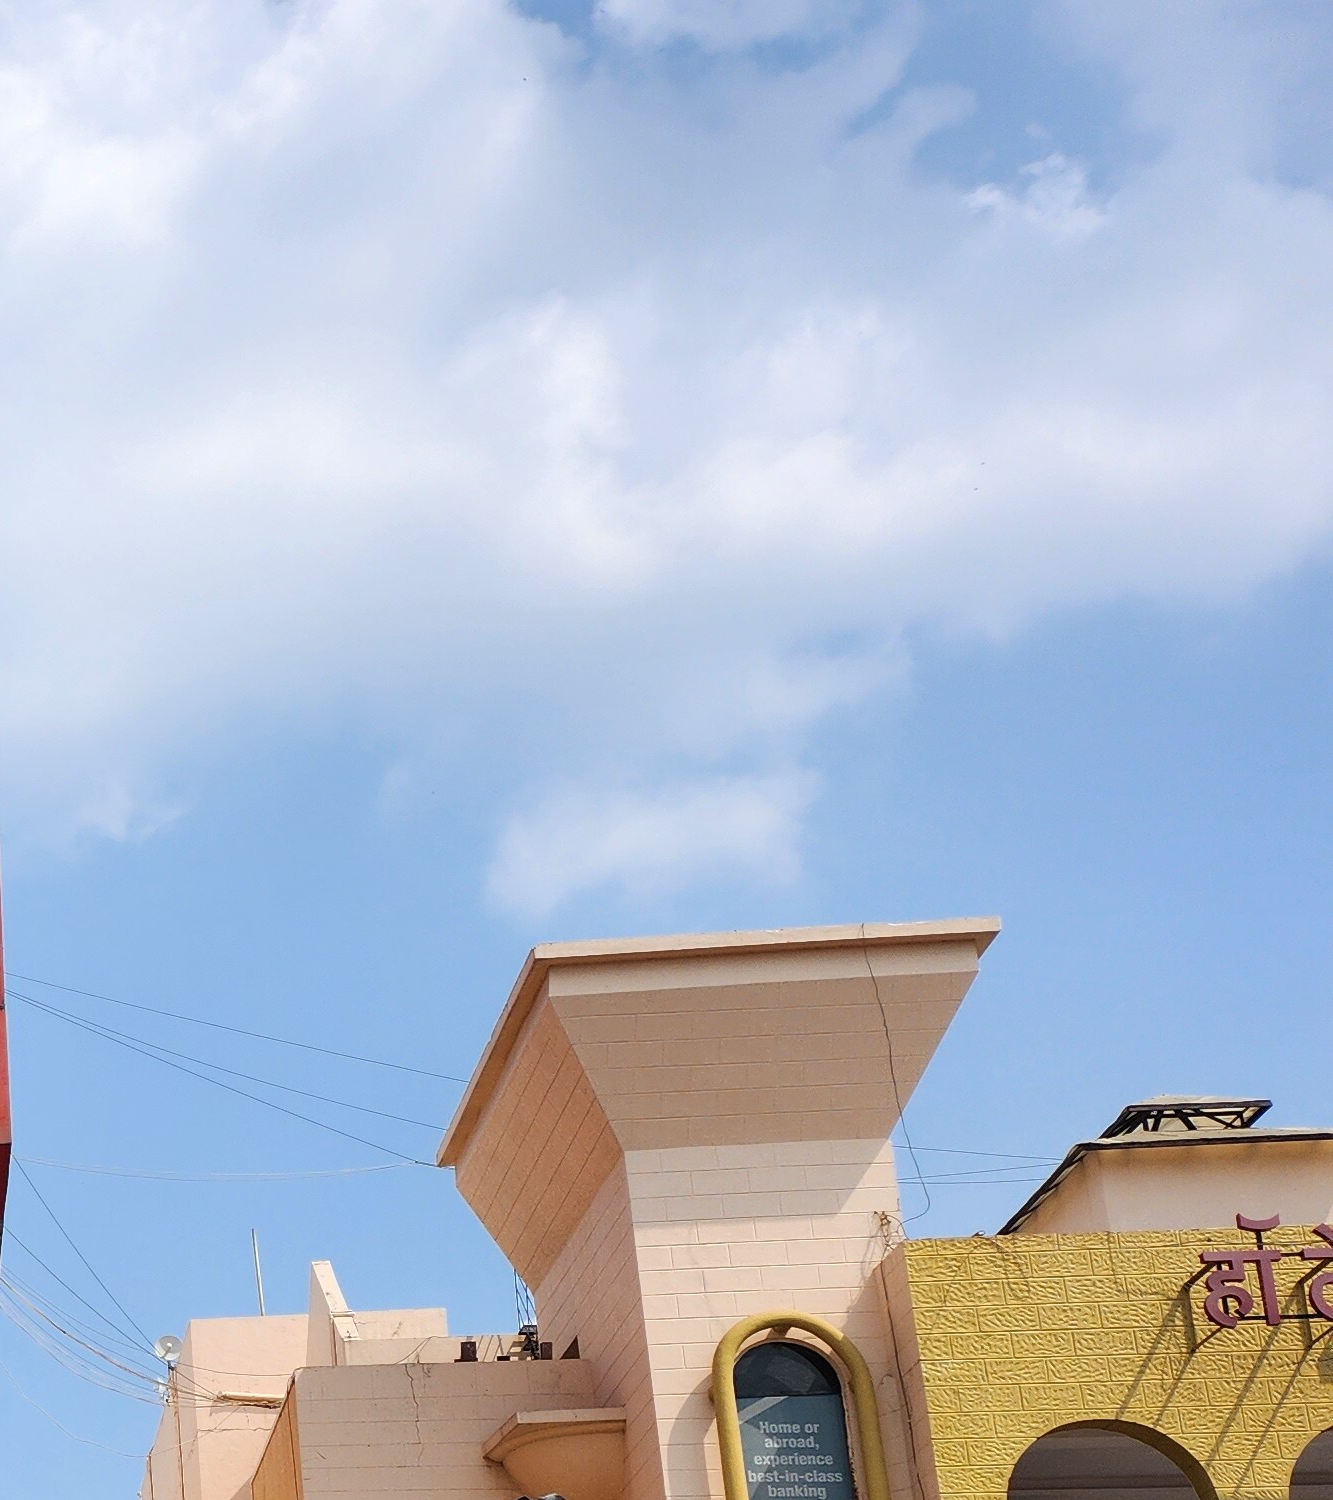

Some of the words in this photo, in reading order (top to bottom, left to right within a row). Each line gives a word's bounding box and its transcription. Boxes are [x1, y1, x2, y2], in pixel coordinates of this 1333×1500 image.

[759, 1421, 800, 1434] Home
[804, 1423, 820, 1434] or
[764, 1436, 820, 1450] abroad,
[753, 1452, 834, 1467] experience
[747, 1470, 843, 1482] best-in-class
[767, 1484, 828, 1500] banking
